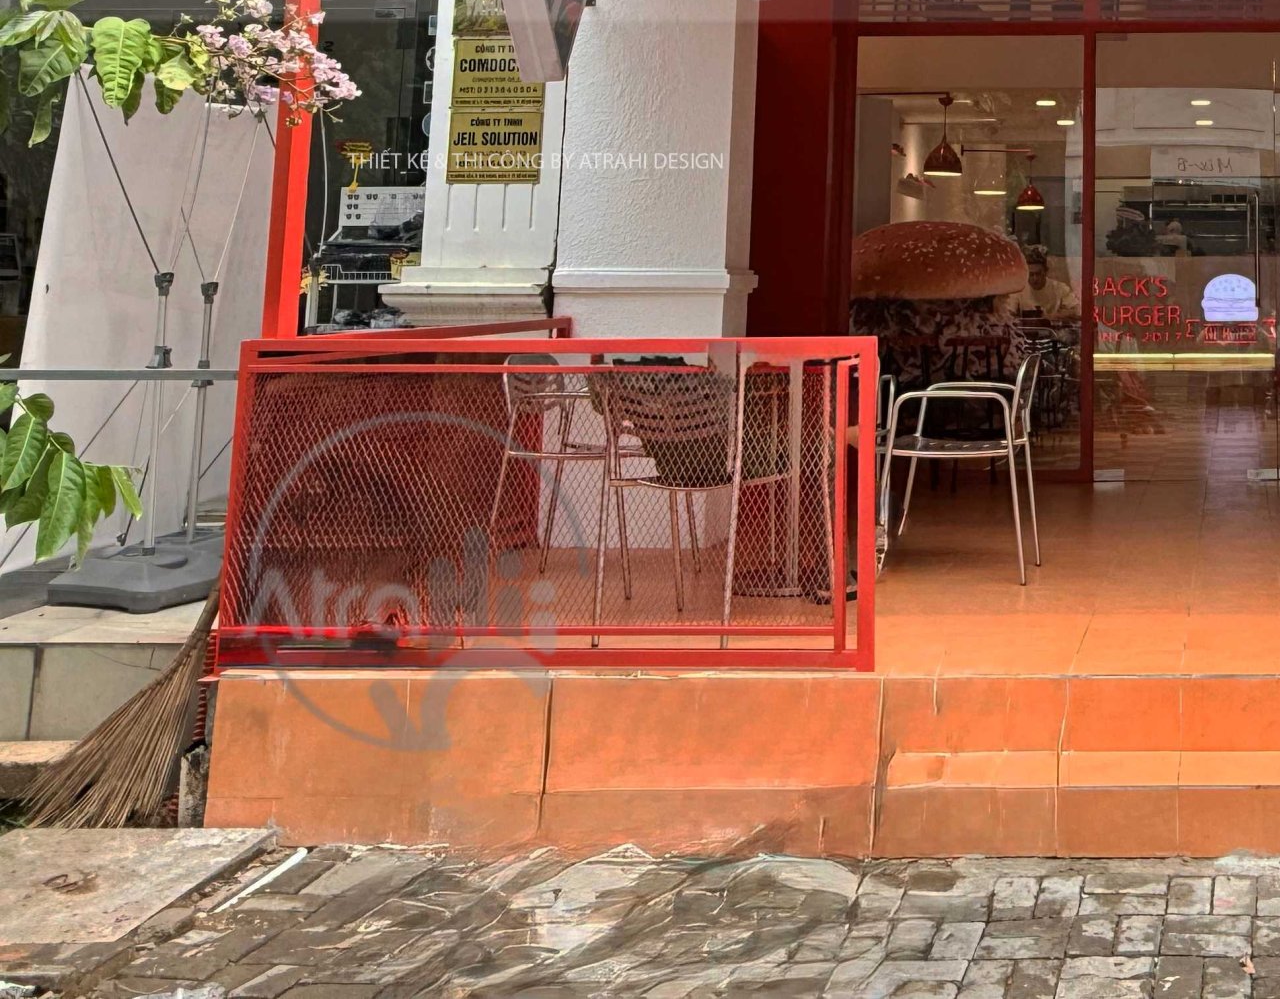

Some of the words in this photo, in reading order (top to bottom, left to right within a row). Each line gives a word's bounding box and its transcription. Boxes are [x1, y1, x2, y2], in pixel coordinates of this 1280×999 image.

[459, 58, 520, 73] COMDOC
[453, 132, 478, 146] JEIL
[481, 131, 538, 146] SOLUTION
